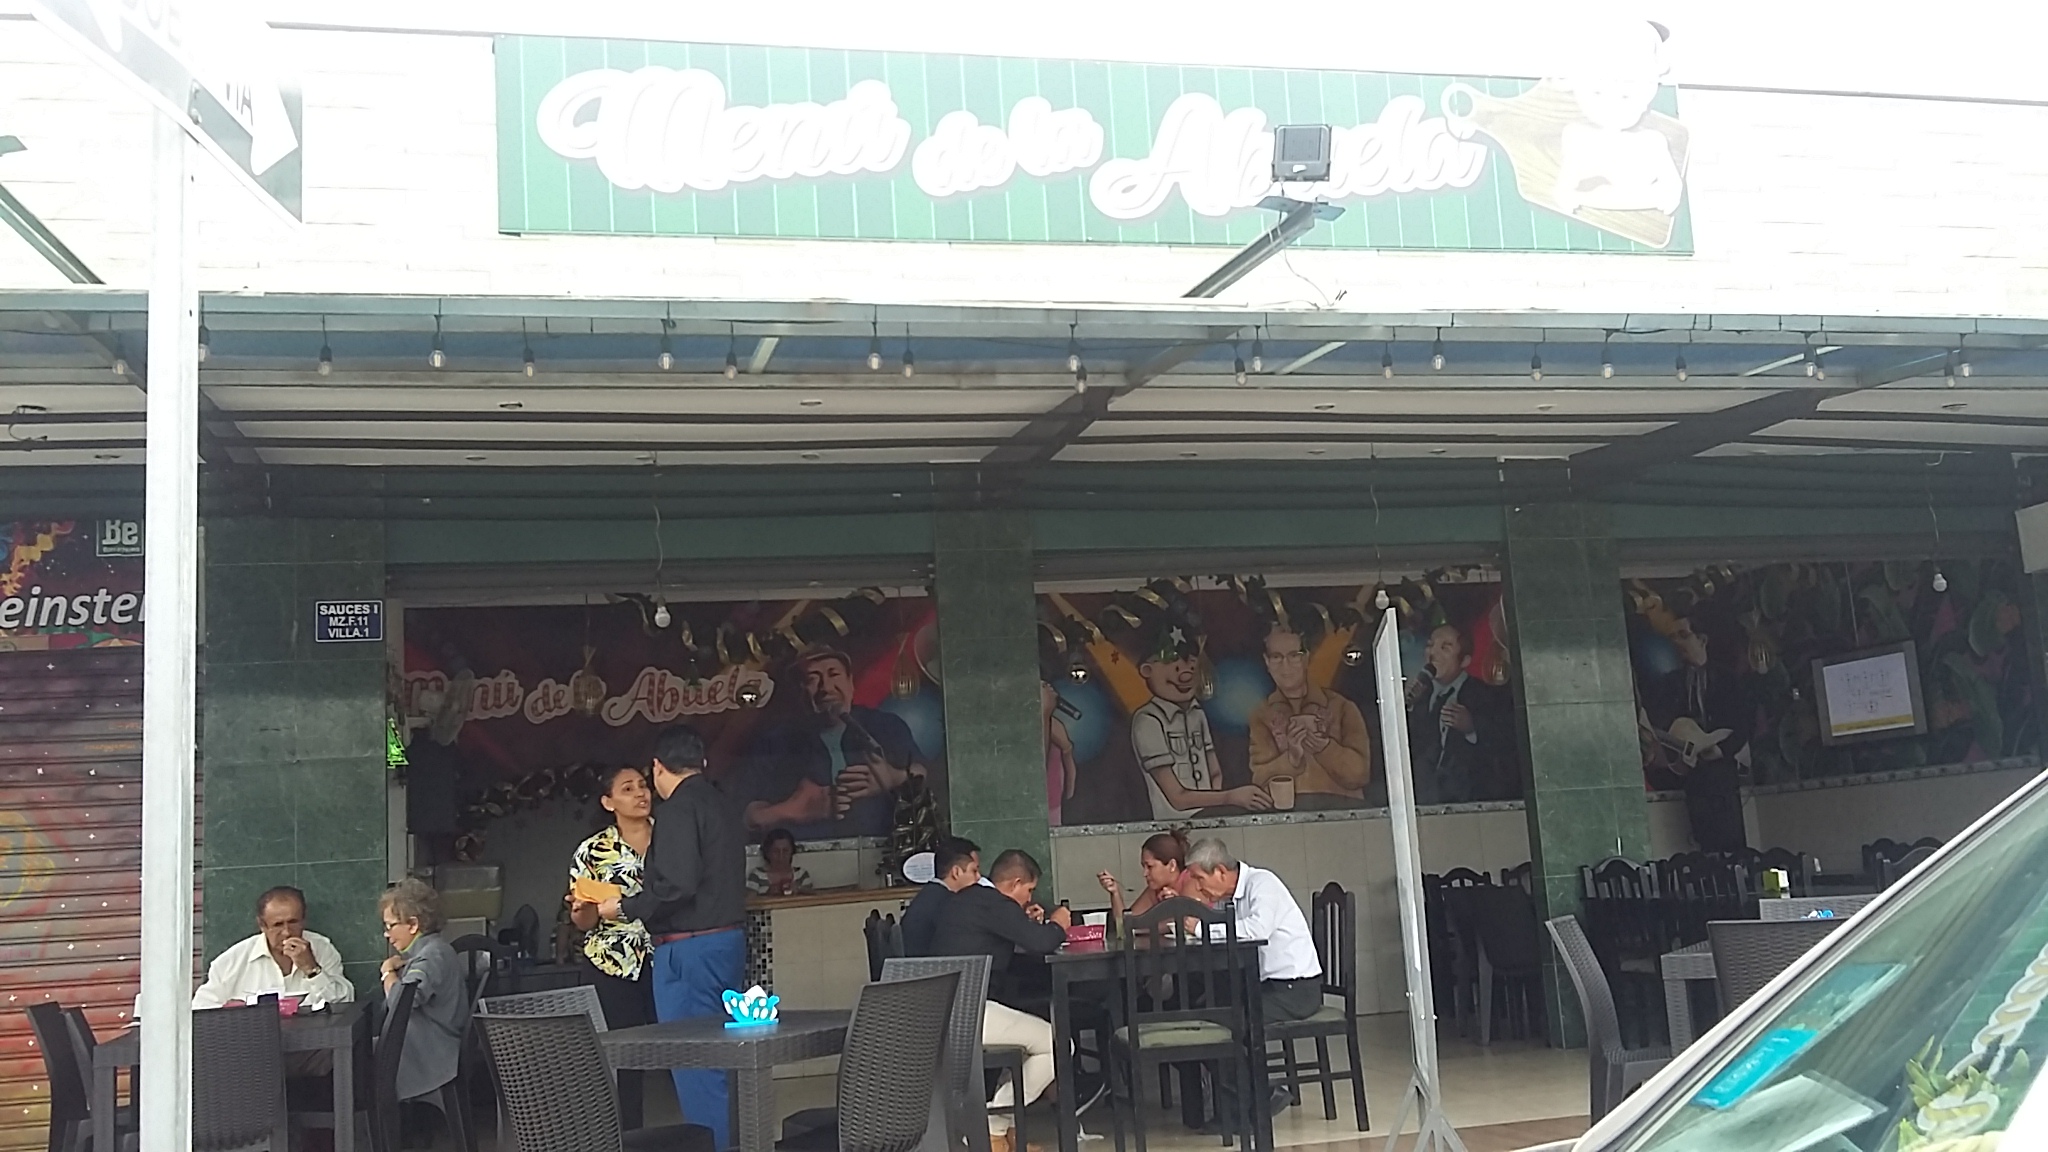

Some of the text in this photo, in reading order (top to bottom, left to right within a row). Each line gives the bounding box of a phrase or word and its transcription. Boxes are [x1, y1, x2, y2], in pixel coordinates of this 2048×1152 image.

[912, 110, 1012, 196] de
[1009, 96, 1103, 176] la
[319, 603, 371, 616] SAUCES
[327, 627, 369, 638] VILLA.1
